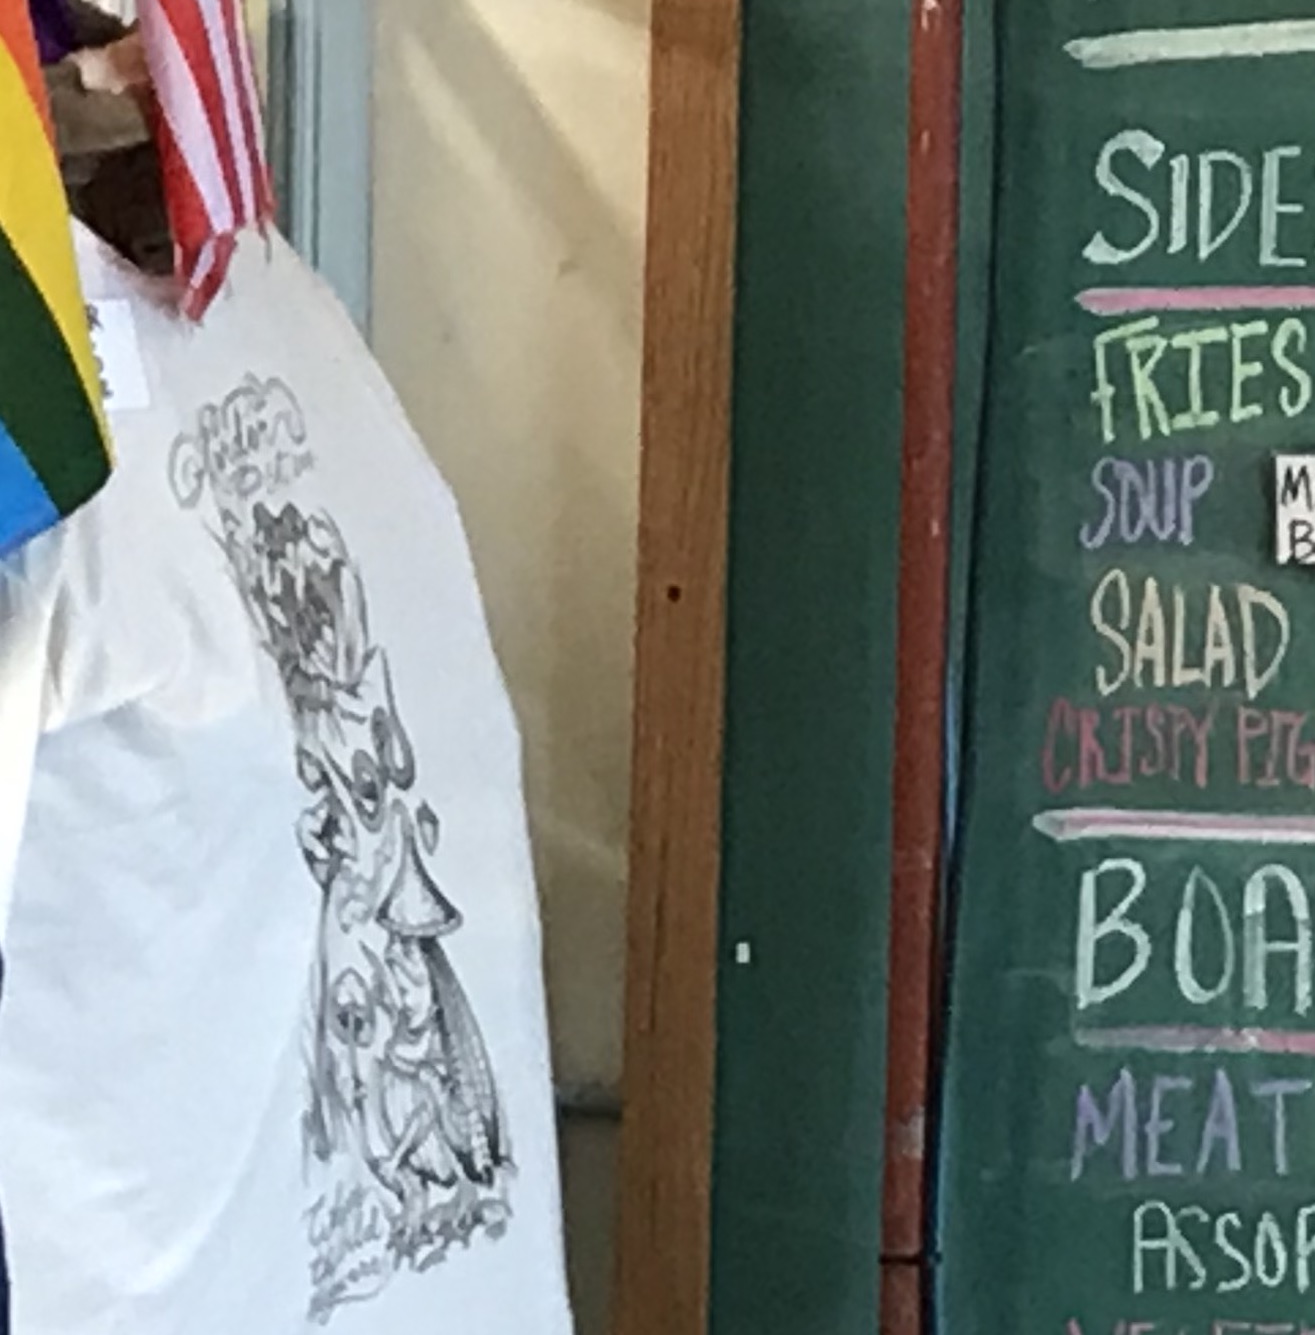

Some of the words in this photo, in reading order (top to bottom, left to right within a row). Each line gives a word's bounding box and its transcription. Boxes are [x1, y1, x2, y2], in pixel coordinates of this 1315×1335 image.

[1091, 314, 1312, 445] FRIES
[1080, 454, 1217, 550] SOUP
[1089, 569, 1290, 698] SALAD
[1042, 697, 1213, 793] CRISPY
[1069, 1067, 1312, 1182] MEAT
